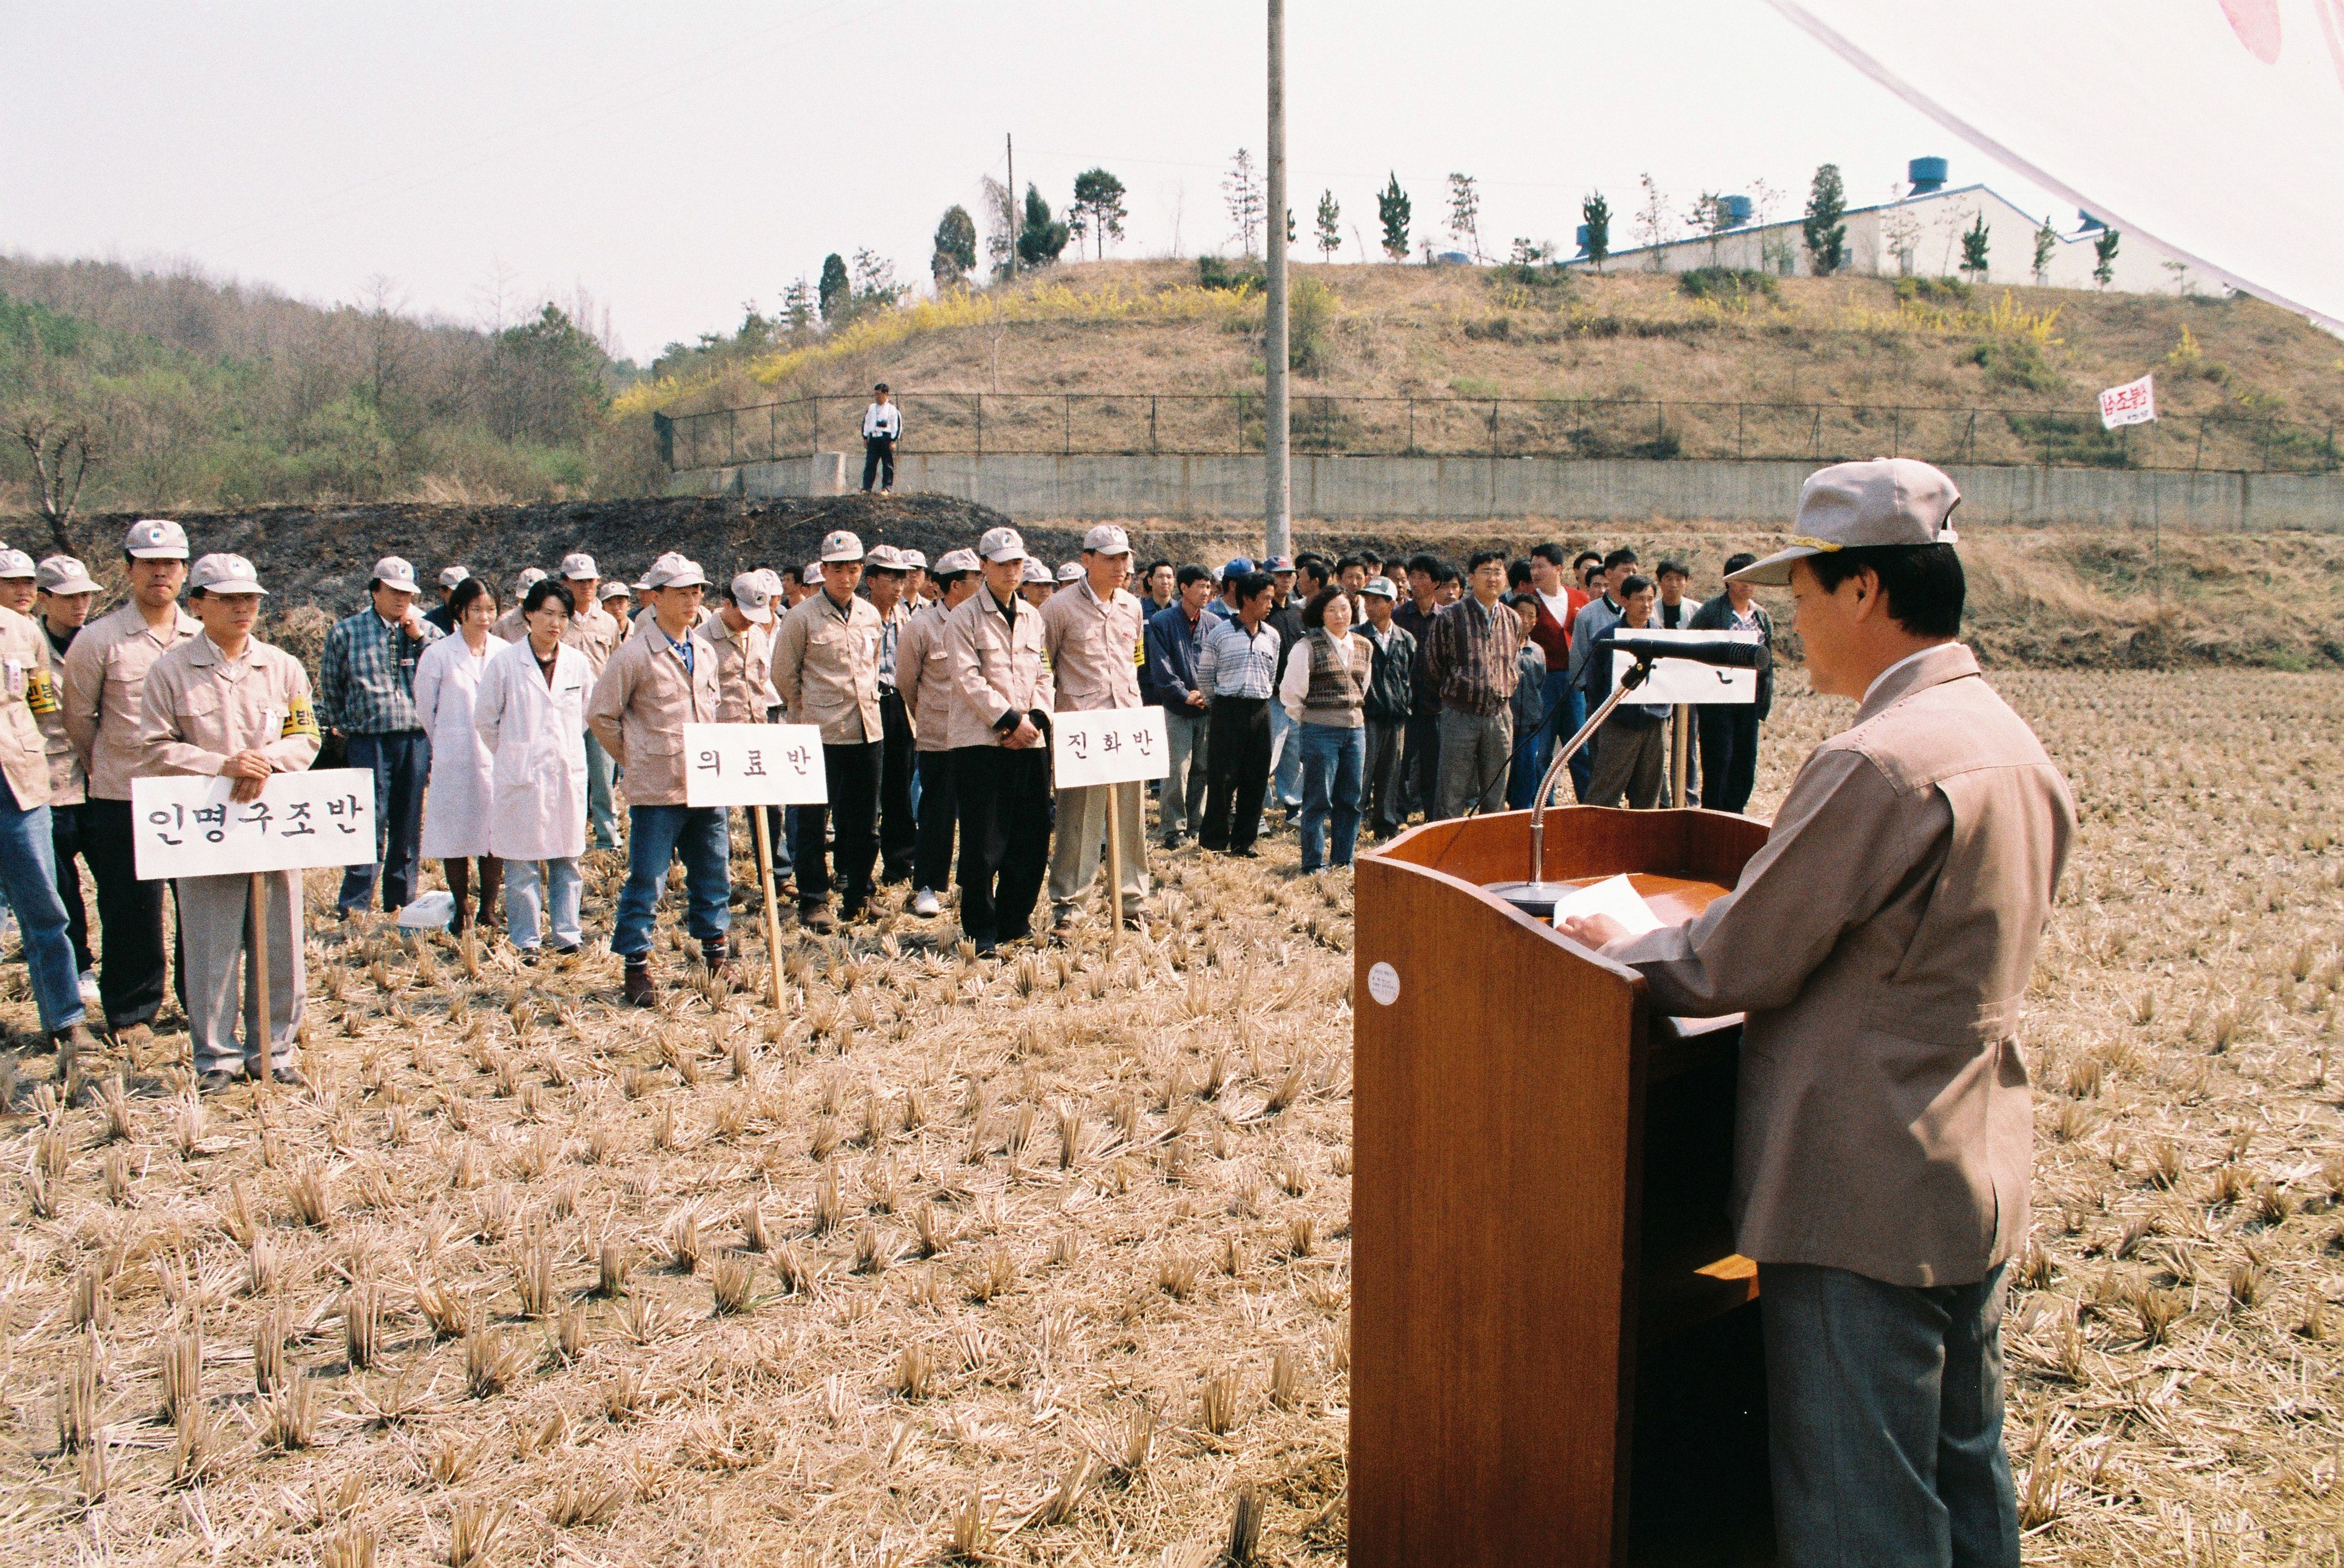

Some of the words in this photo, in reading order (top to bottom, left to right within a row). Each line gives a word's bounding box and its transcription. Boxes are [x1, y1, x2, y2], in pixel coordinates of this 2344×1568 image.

[1067, 729, 1153, 759] 진화반
[697, 745, 811, 778] 의료반
[149, 794, 363, 845] 인명구조반
